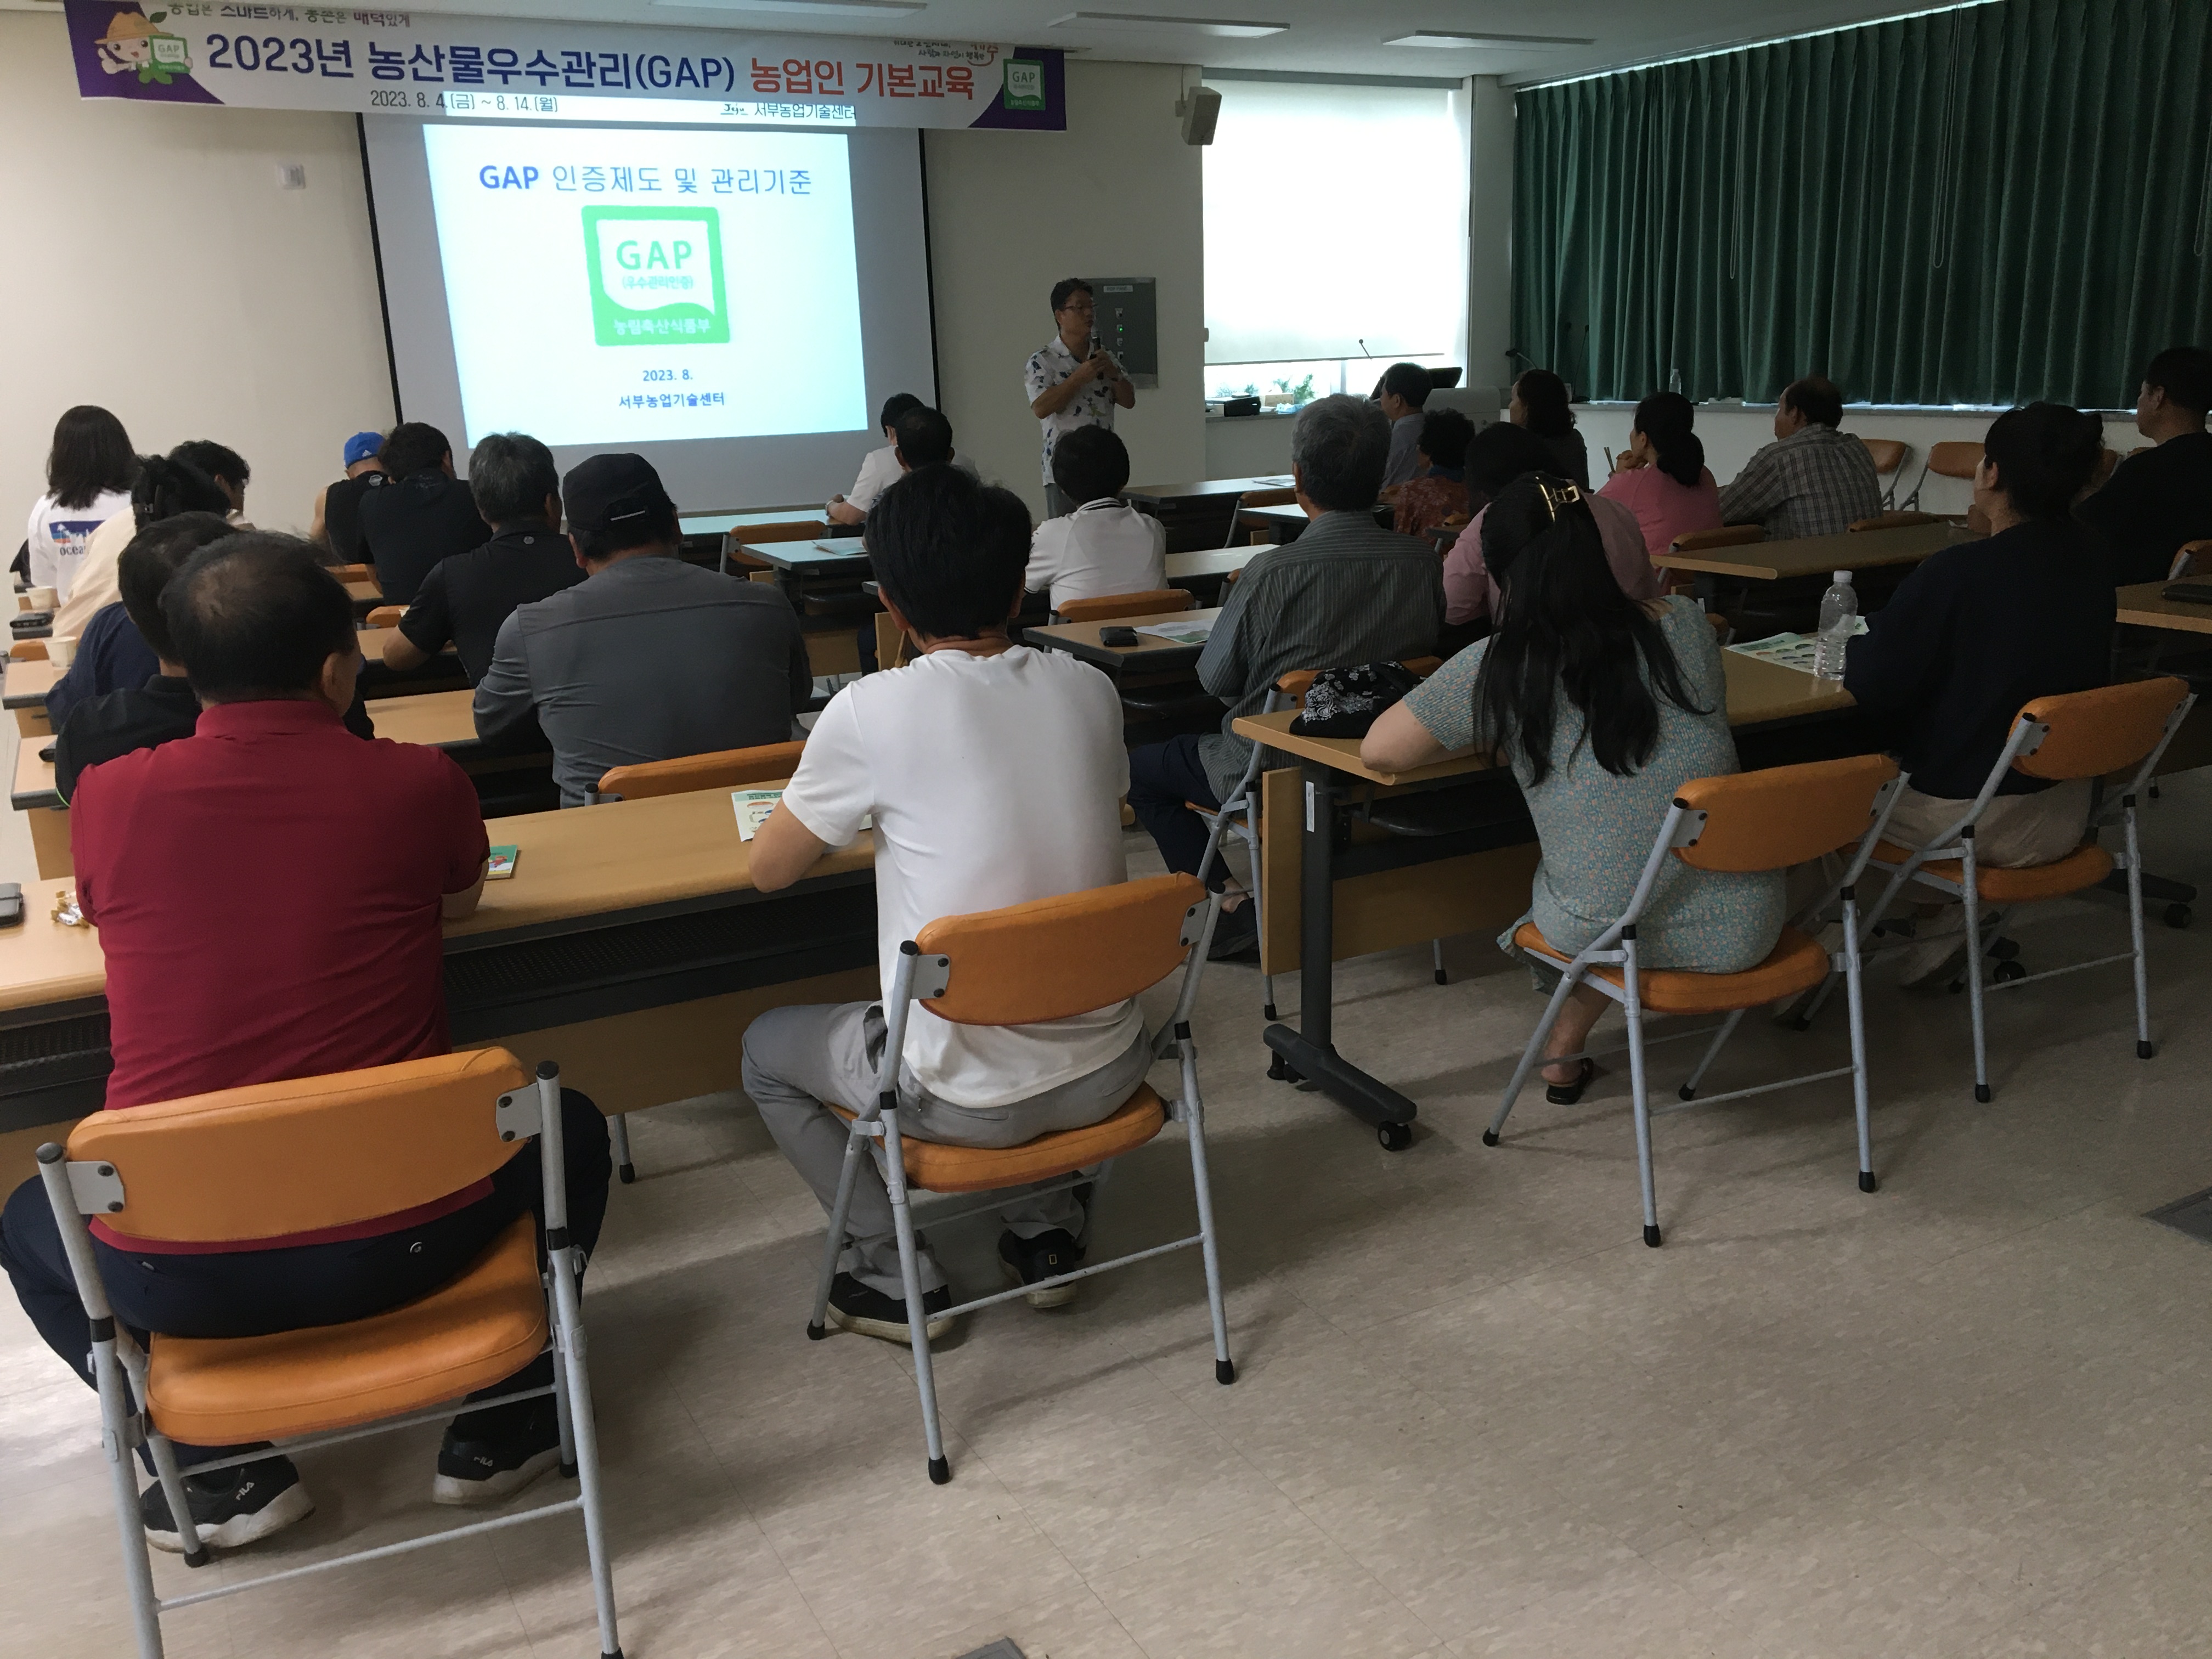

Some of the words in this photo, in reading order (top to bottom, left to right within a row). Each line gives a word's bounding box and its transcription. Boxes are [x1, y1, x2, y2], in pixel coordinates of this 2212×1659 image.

[207, 33, 354, 79] 2023년
[368, 40, 735, 92] 농산물우수관리(GAP)
[749, 57, 845, 95] 농업인
[856, 63, 975, 100] 기본교육
[1012, 71, 1035, 83] GAP
[370, 89, 411, 107] 2023.
[416, 92, 430, 108] 8.
[496, 95, 509, 111] 8.
[754, 102, 857, 120] 서부농업기술센터
[479, 166, 539, 190] GAP
[552, 165, 664, 193] 인증제도
[675, 167, 698, 194] 및
[710, 167, 812, 195] 관리기준
[616, 239, 692, 270] GAP
[622, 275, 693, 290] (우수관리인증)
[613, 318, 711, 336] 농림축산식품부
[642, 370, 678, 382] 2023.
[682, 369, 694, 380] 8.
[618, 391, 725, 410] 서부농업기술센터
[59, 545, 86, 556] ocea
[235, 1482, 255, 1501] FILA
